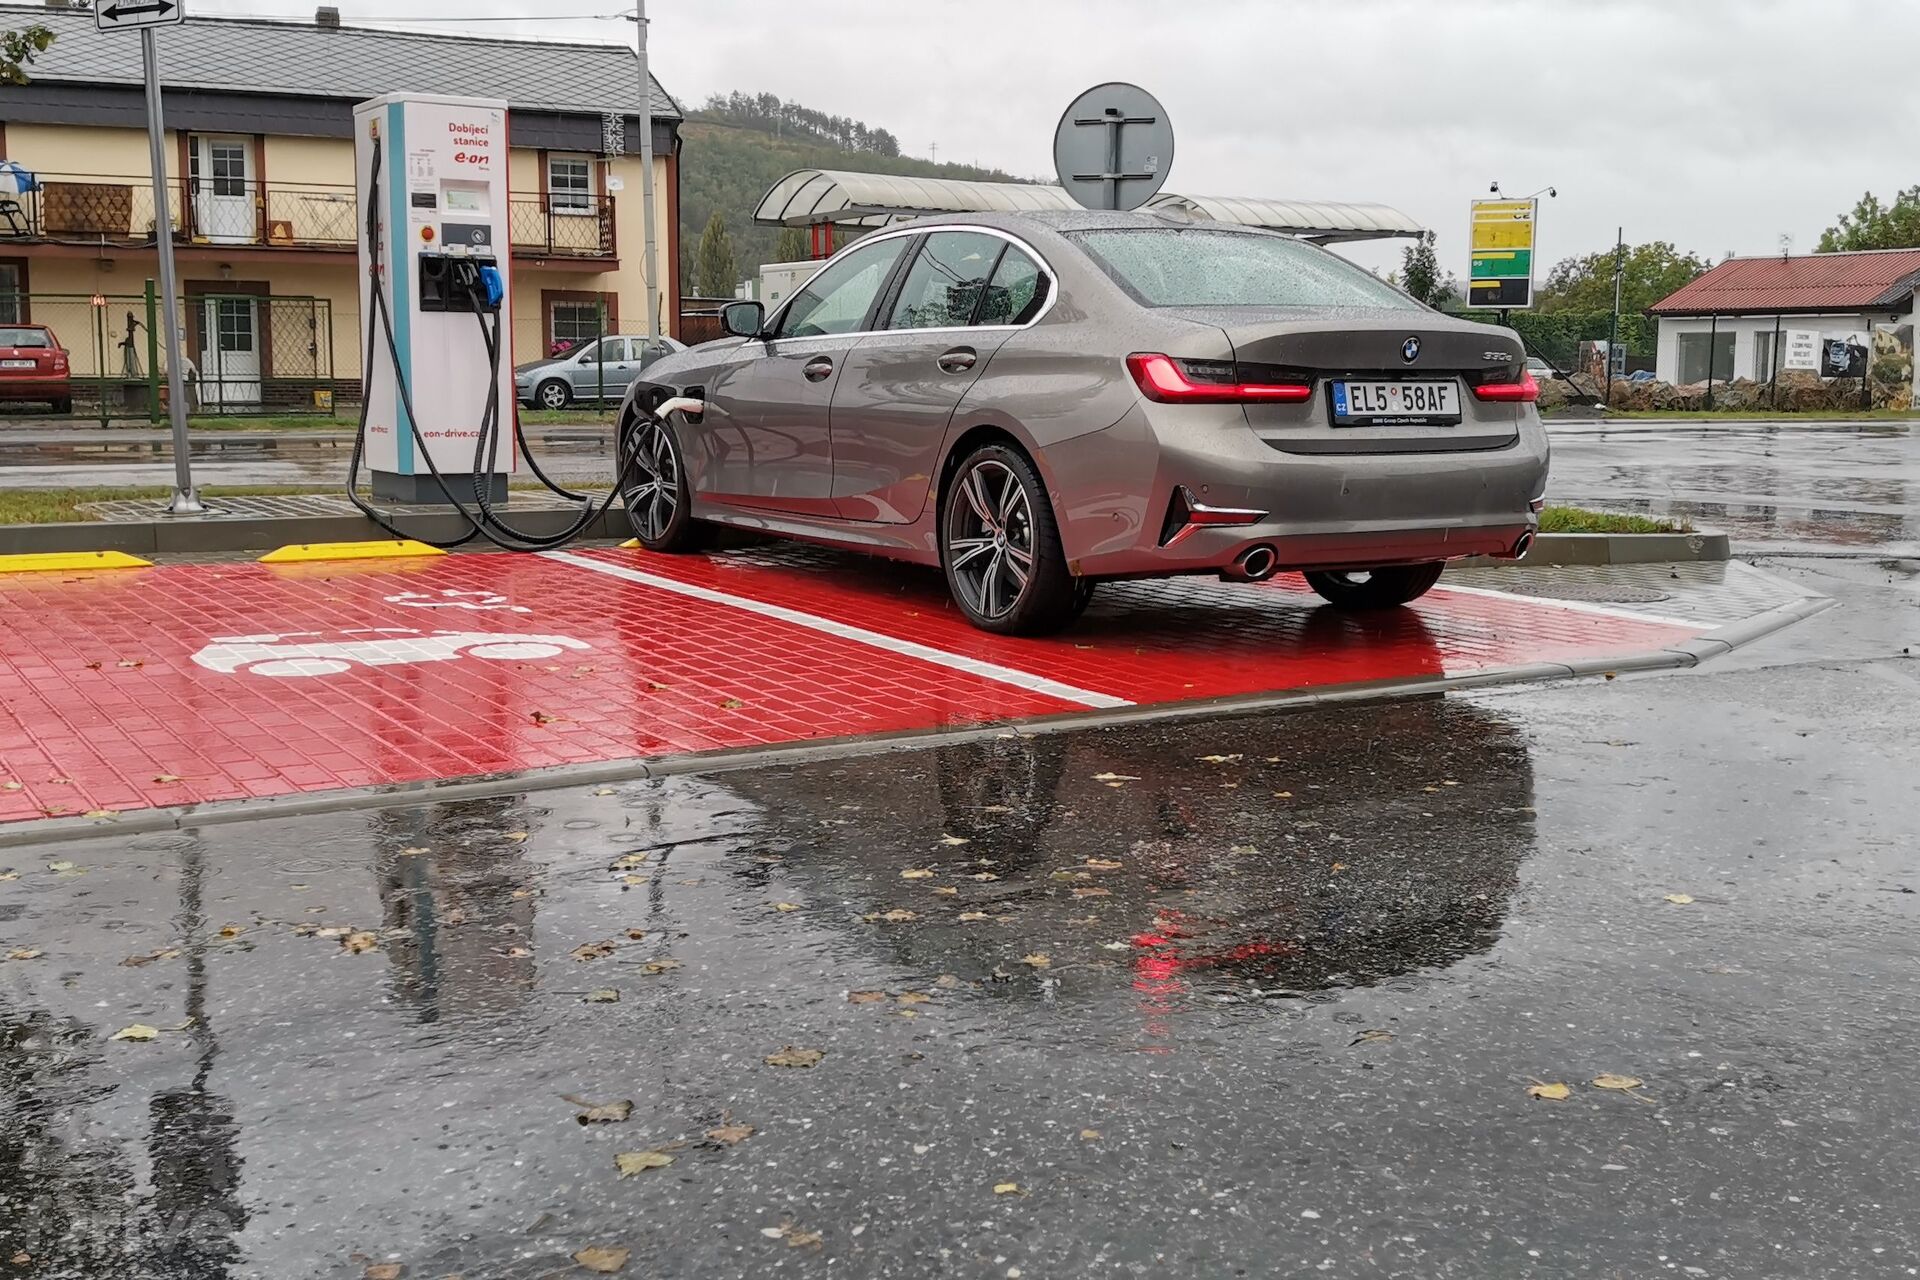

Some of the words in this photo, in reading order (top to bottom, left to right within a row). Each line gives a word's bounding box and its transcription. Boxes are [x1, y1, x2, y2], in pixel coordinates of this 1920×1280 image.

[453, 137, 489, 147] stanice
[1482, 351, 1513, 361] 330e
[1350, 386, 1387, 411] EL5
[1402, 386, 1448, 411] 58AF
[1336, 403, 1347, 411] CZ
[423, 429, 481, 438] eon-drive.cz
